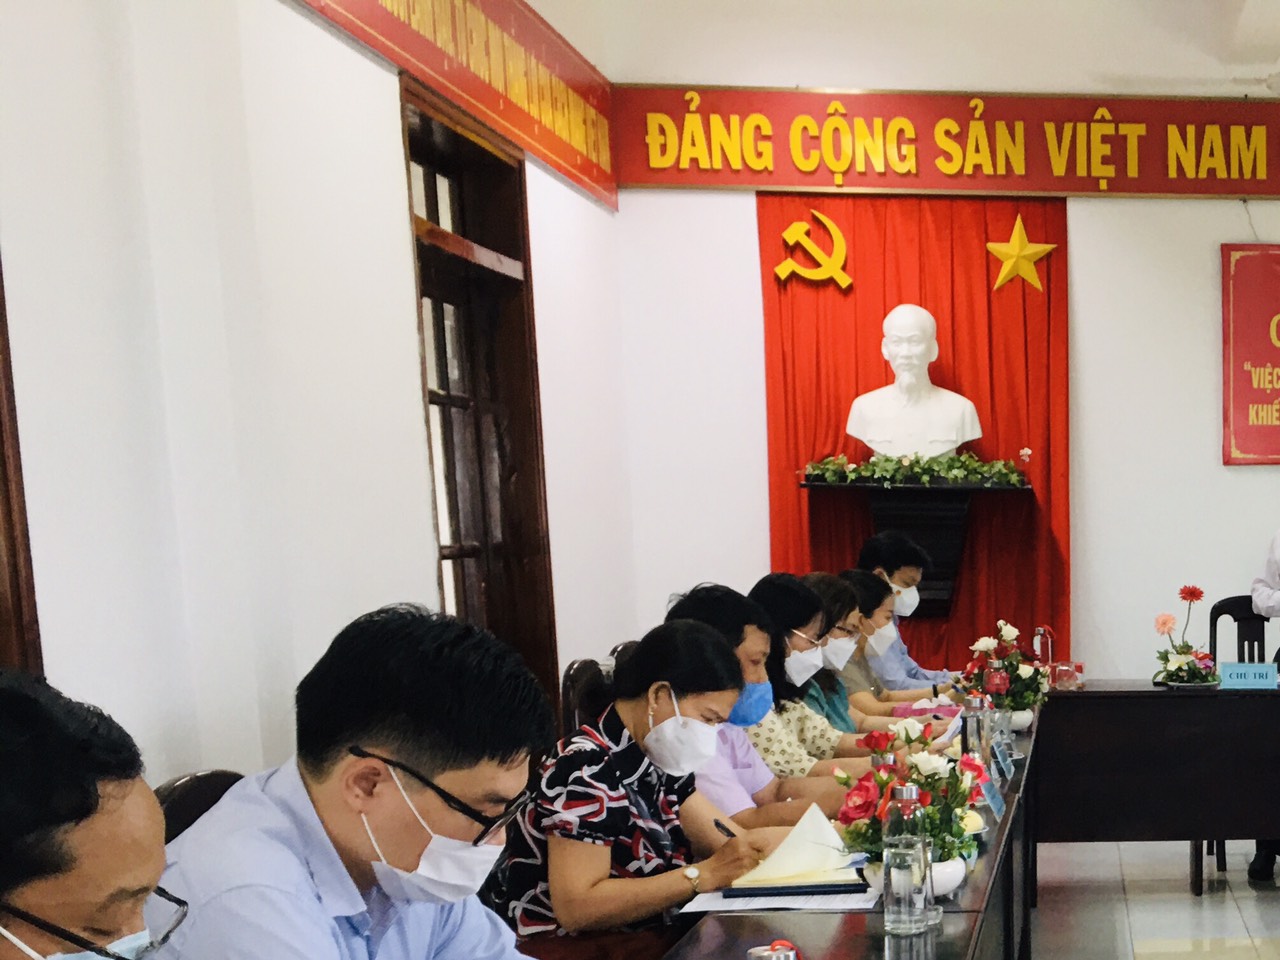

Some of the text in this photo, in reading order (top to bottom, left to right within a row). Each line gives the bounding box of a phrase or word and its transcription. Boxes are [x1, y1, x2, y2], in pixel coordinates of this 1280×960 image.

[646, 91, 774, 171] ĐẢNG
[789, 101, 917, 185] CỘNG
[934, 99, 1026, 176] SẢN
[1044, 107, 1146, 190] VIỆT
[1167, 124, 1267, 180] NAM
